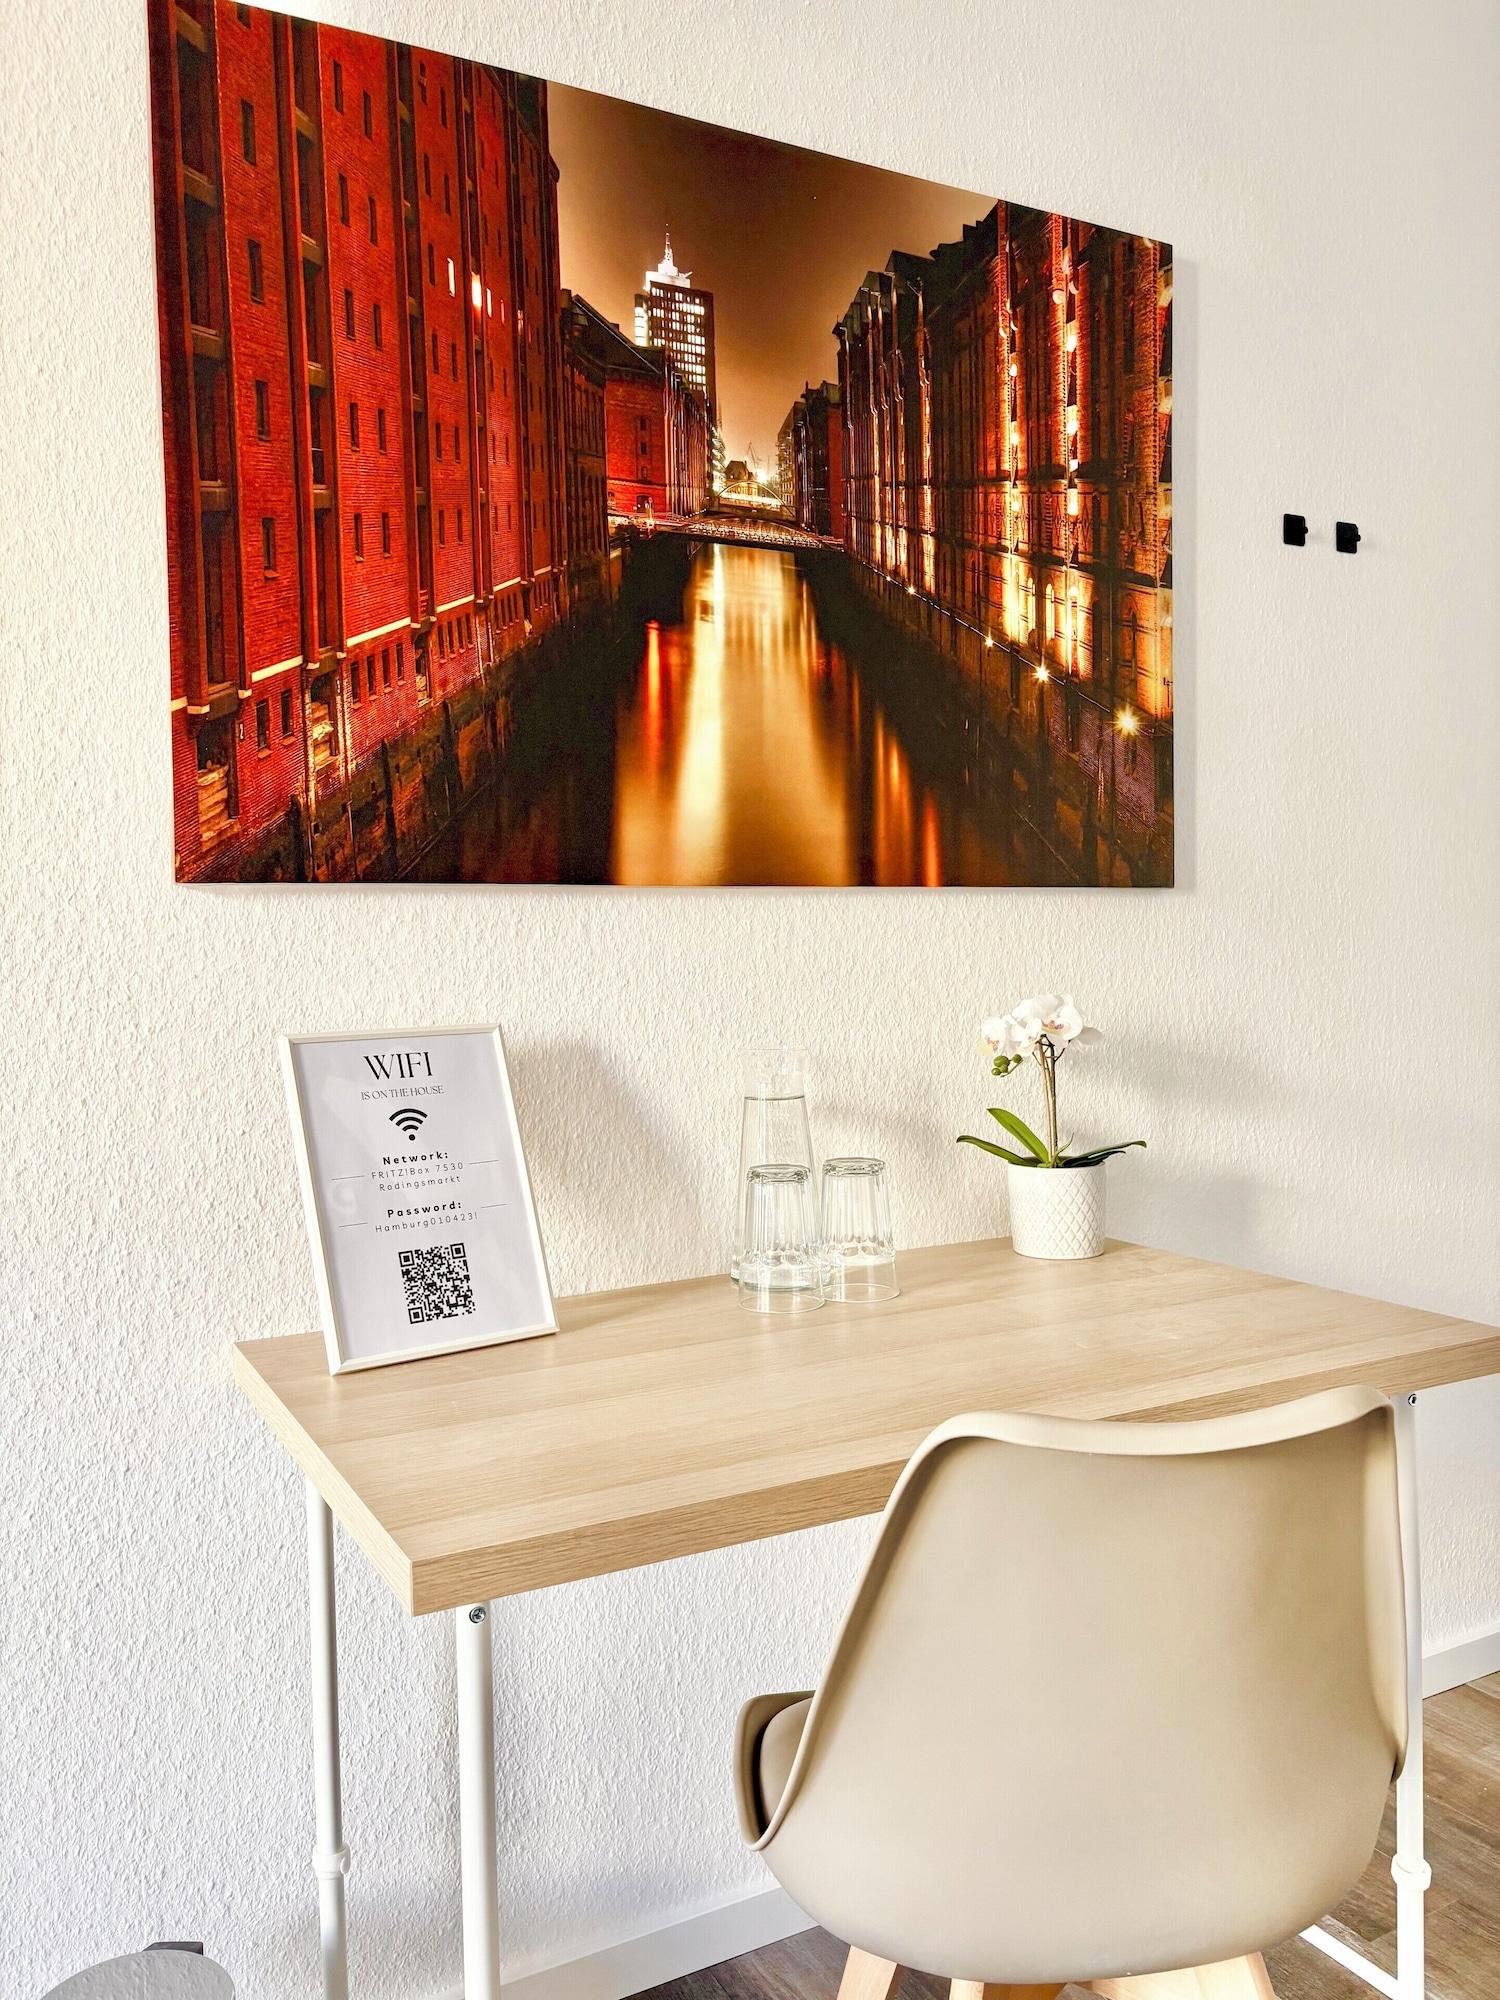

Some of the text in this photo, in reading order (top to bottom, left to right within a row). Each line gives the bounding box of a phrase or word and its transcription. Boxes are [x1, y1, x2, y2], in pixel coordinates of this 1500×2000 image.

[363, 1051, 433, 1080] WIFI
[360, 1085, 445, 1101] IS ON THE HOUSE
[382, 1151, 449, 1166] Network:
[371, 1162, 464, 1180] FRITZ!Box 7530
[379, 1175, 462, 1192] Rodingsmarkt
[387, 1201, 462, 1219] Password:
